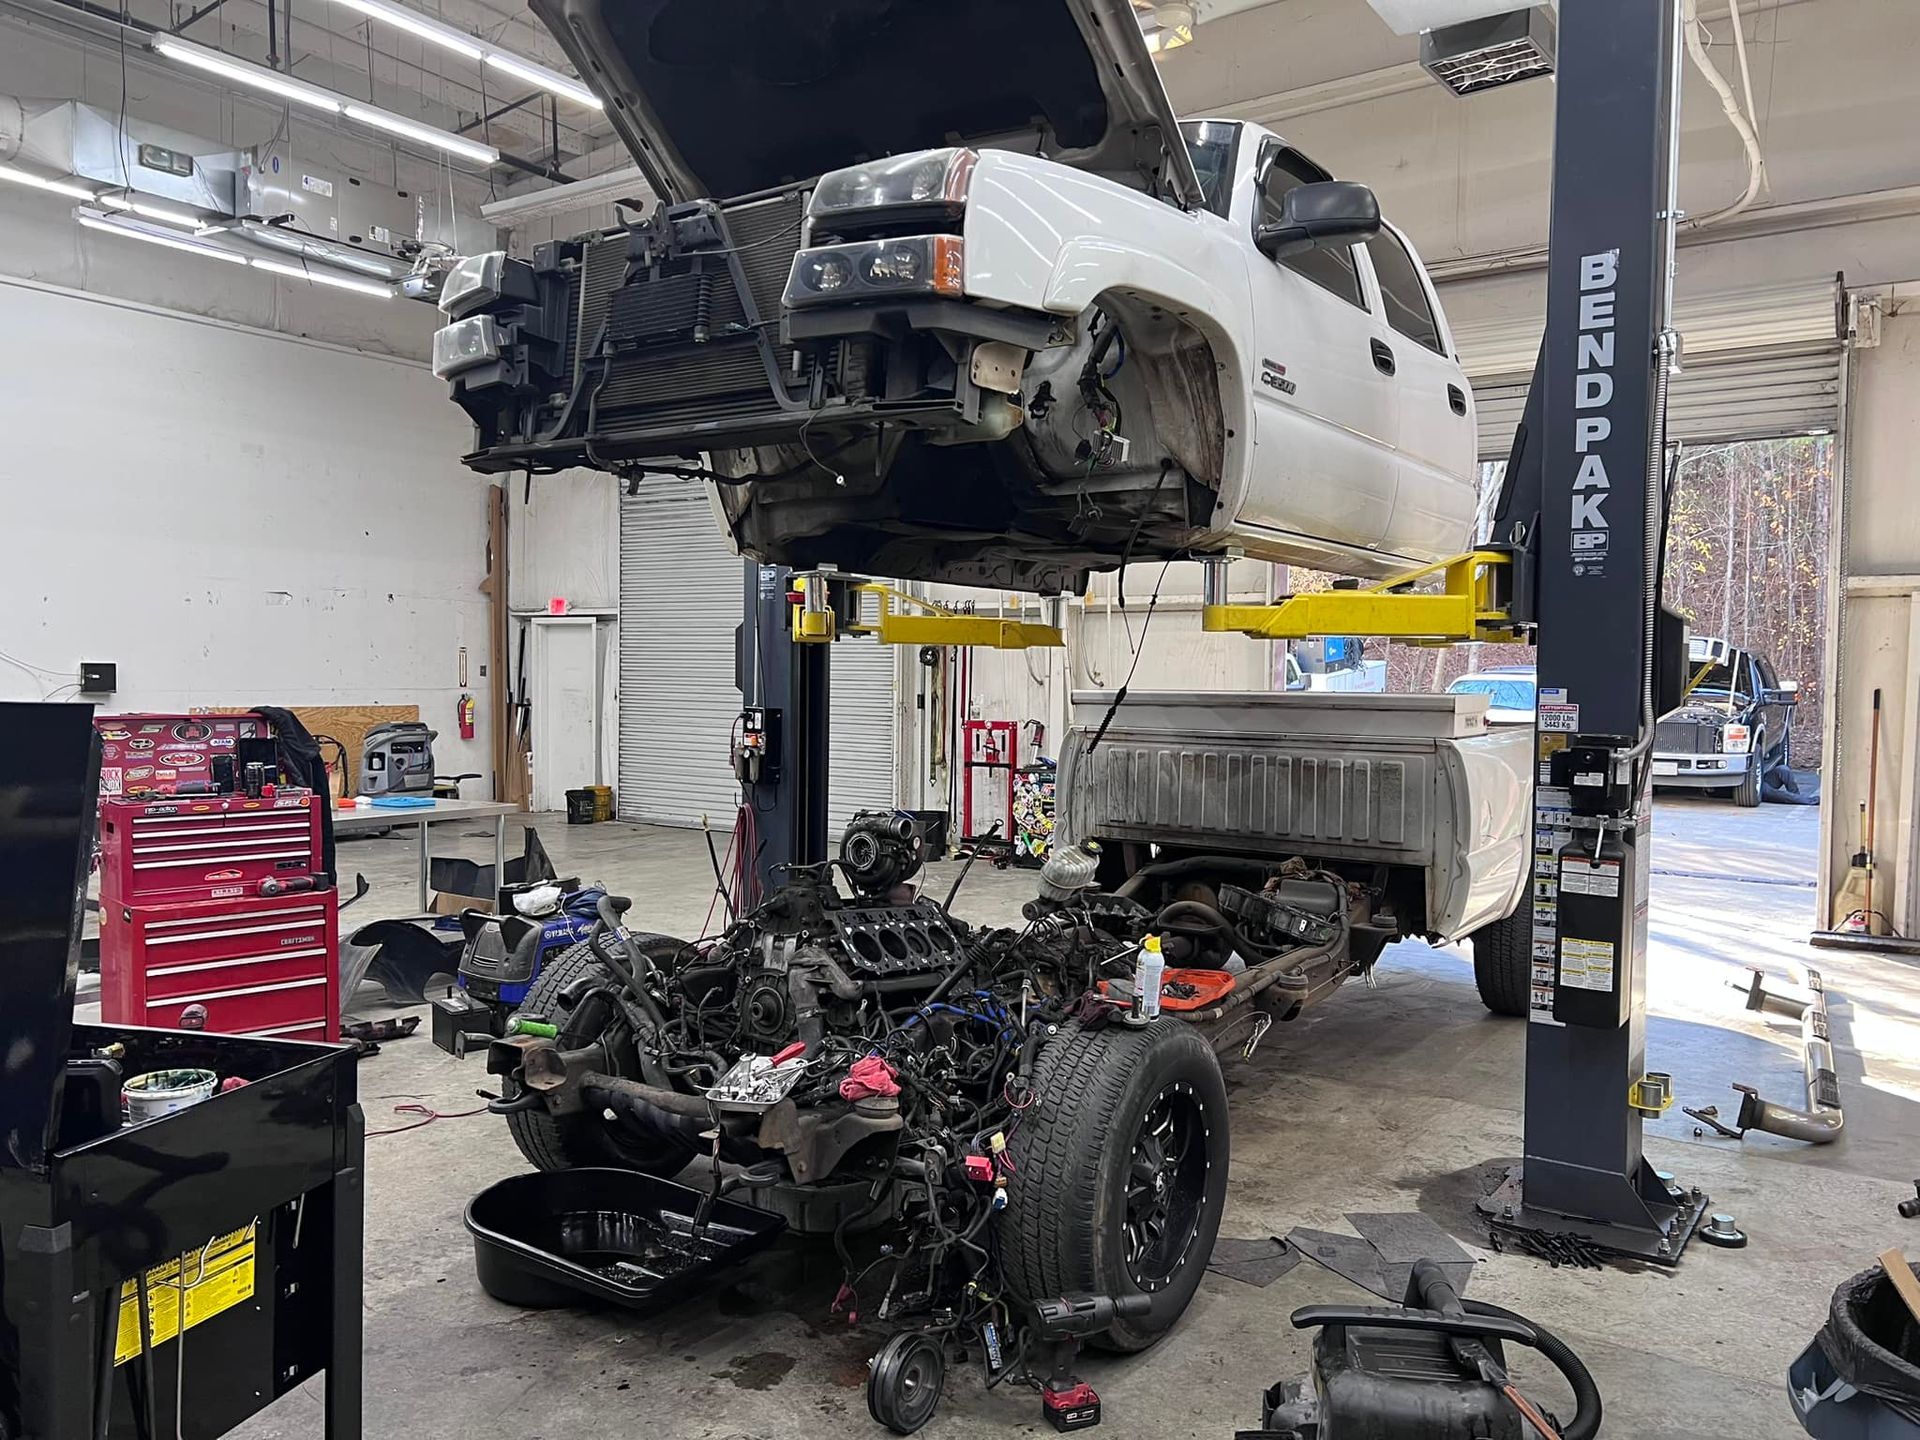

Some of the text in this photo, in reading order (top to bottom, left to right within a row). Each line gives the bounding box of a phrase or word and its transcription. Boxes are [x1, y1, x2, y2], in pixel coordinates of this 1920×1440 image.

[1571, 250, 1619, 528] BENDPAK
[1574, 533, 1606, 548] BP
[760, 570, 775, 580] BP
